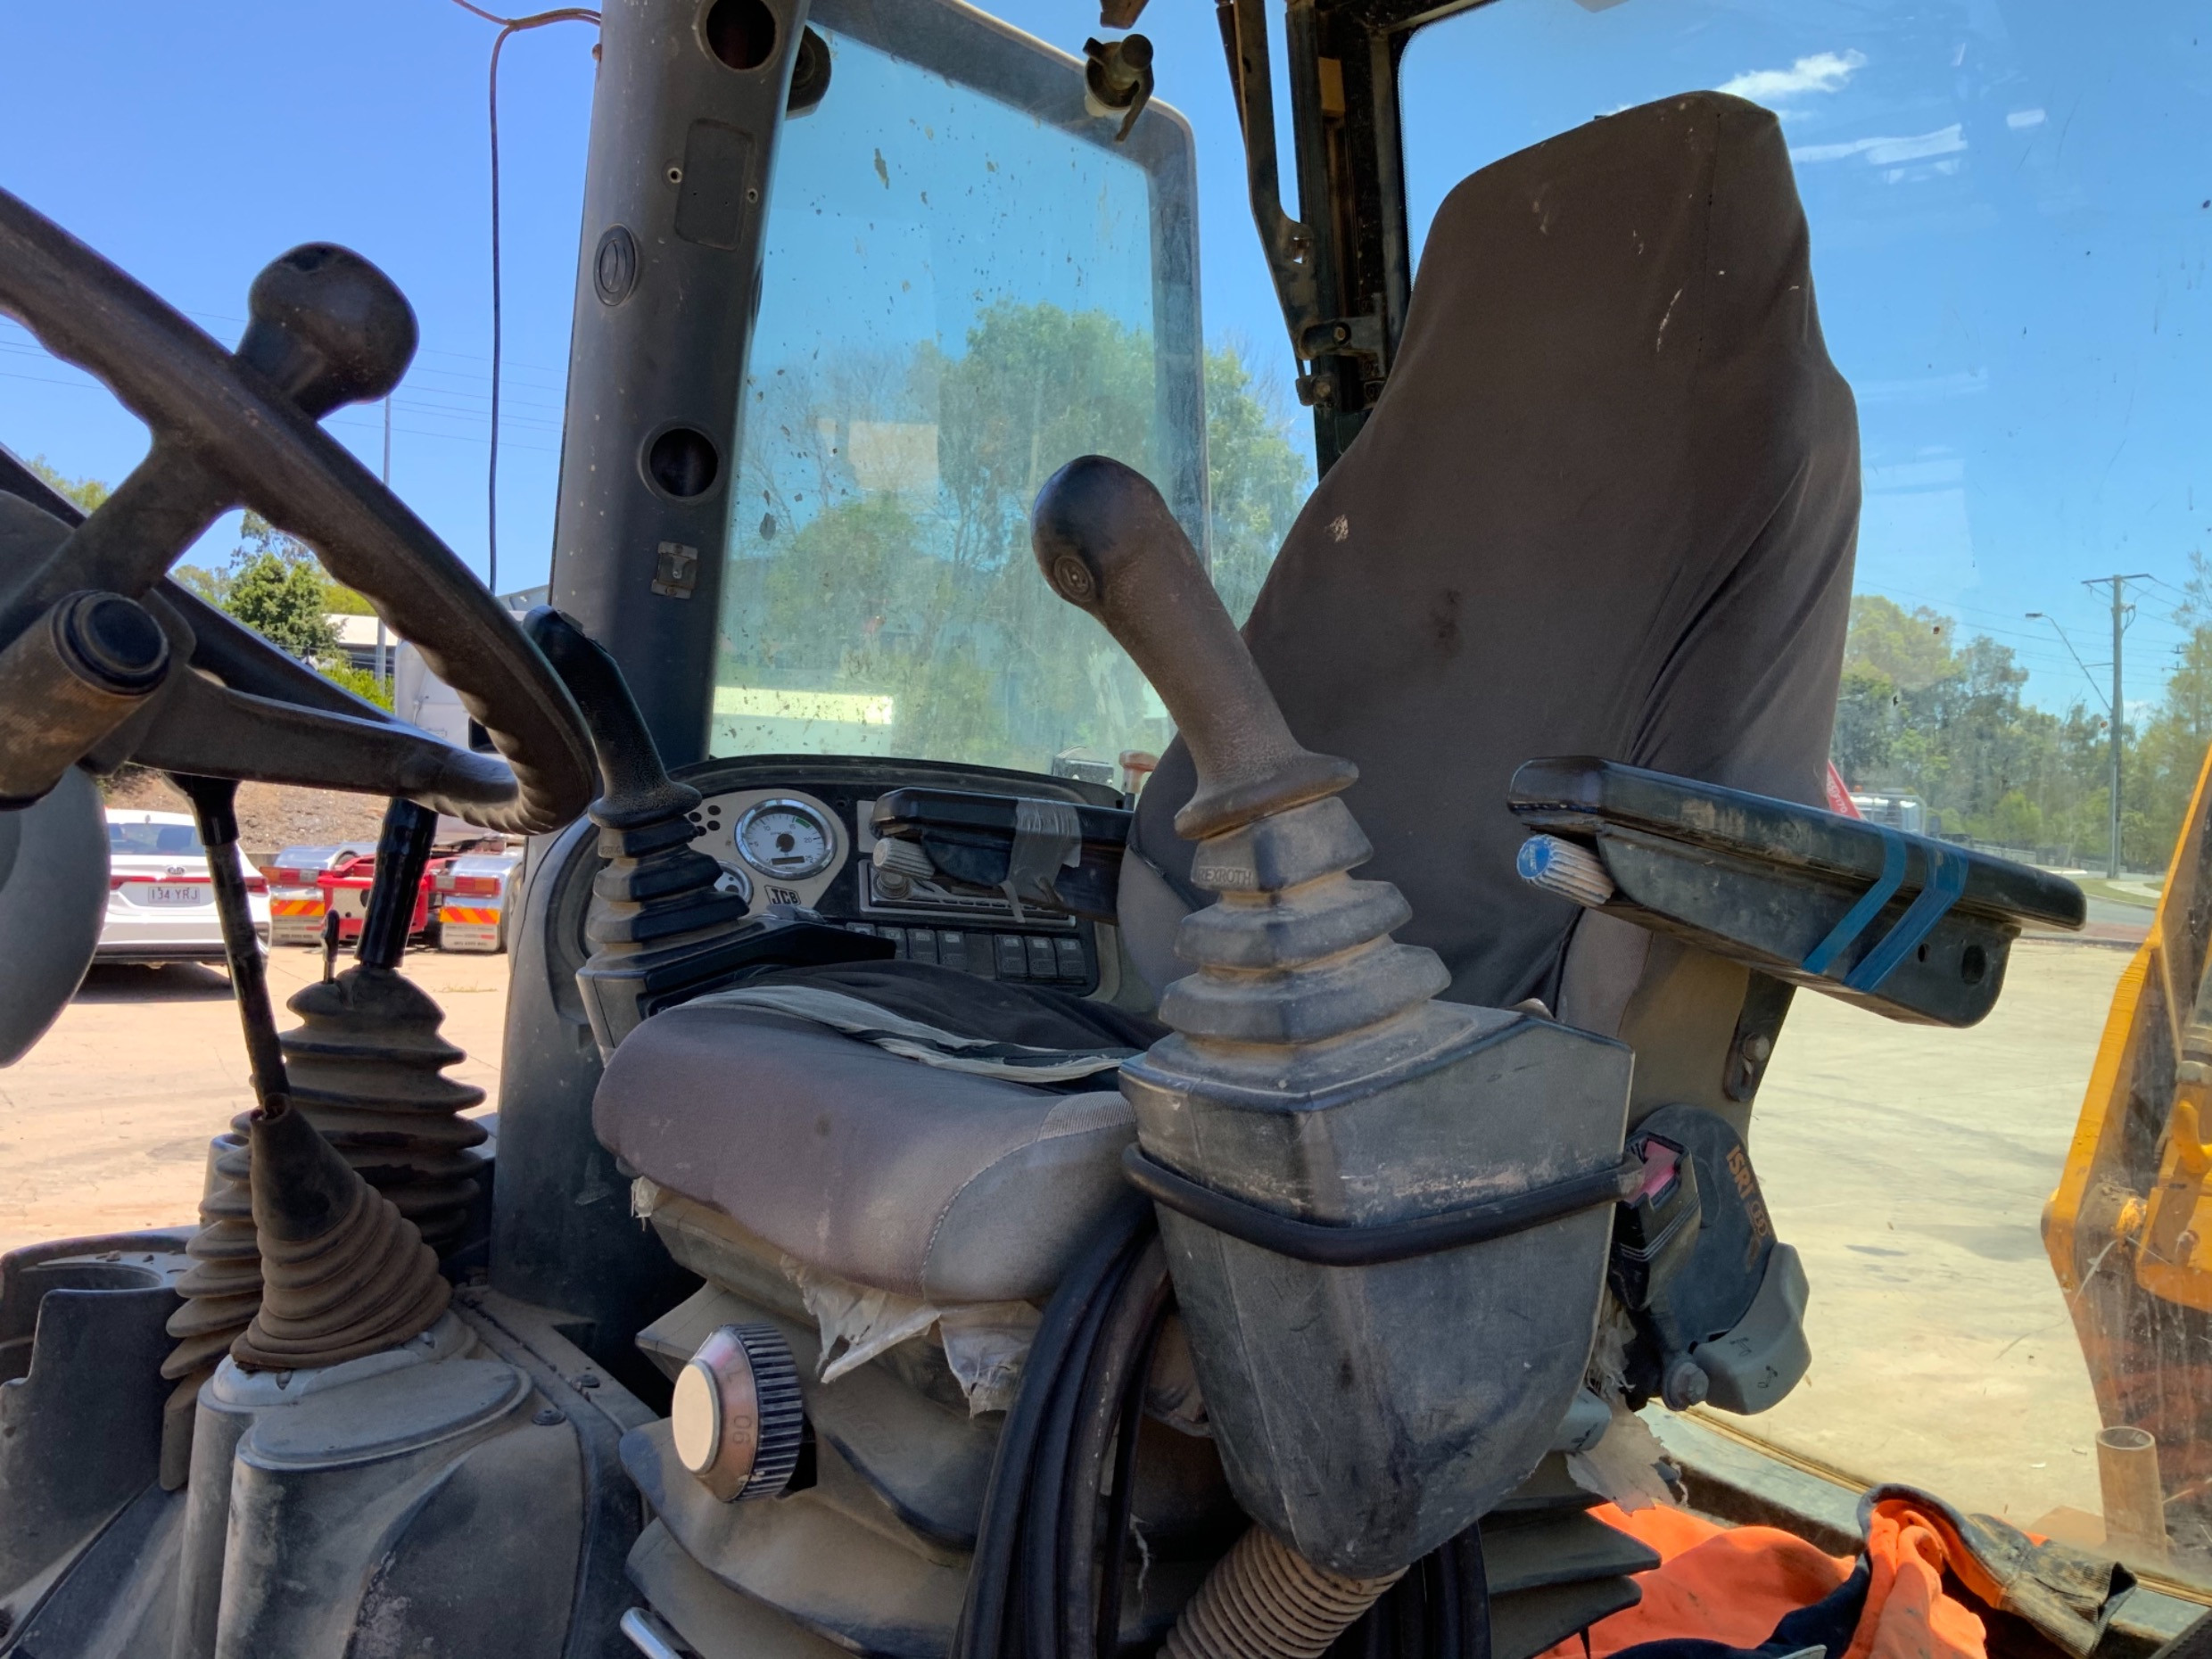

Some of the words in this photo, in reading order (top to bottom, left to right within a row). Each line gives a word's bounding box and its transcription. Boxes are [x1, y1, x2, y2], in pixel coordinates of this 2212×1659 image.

[1199, 869, 1252, 885] REXROTH
[175, 887, 198, 900] YRJ
[772, 888, 798, 904] JCB
[1726, 1144, 1754, 1200] ISRI
